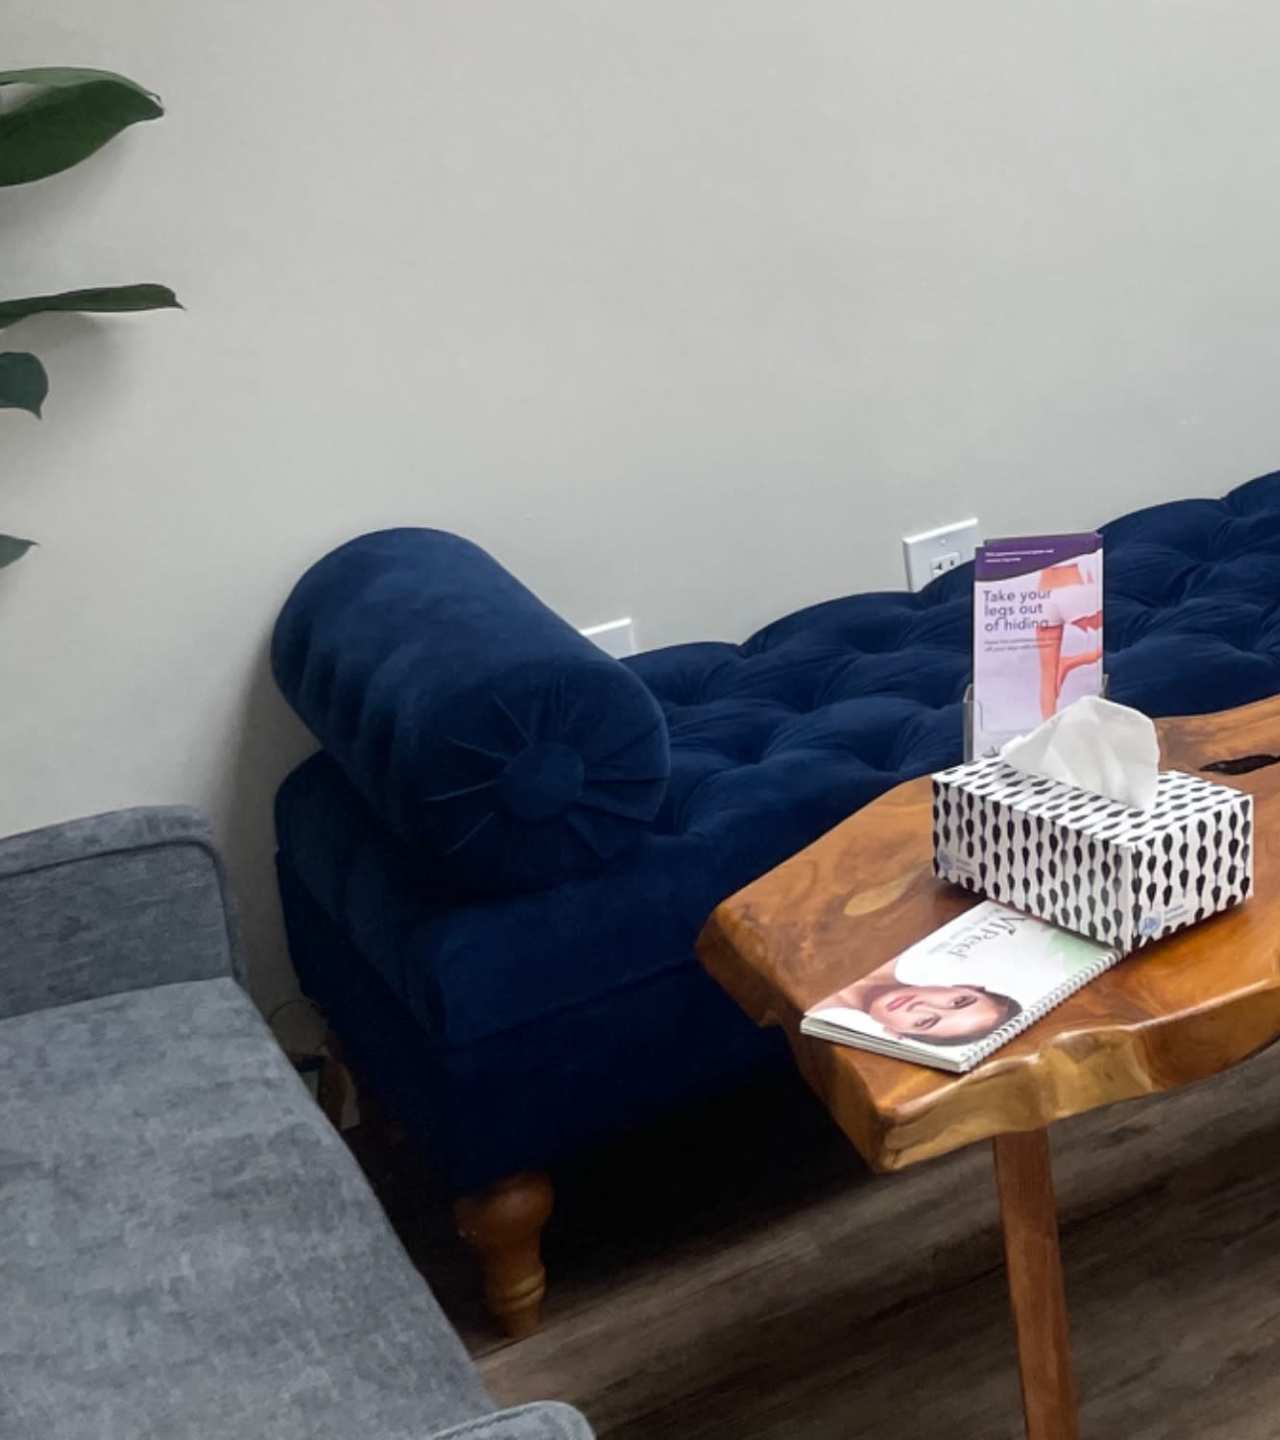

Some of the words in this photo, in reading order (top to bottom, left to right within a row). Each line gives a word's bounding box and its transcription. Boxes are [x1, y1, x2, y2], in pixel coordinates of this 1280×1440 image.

[983, 590, 1016, 602] Take
[1020, 590, 1051, 604] your
[984, 604, 1015, 617] legs
[1019, 603, 1043, 614] out
[984, 617, 1003, 632] of
[1004, 617, 1050, 631] hiding
